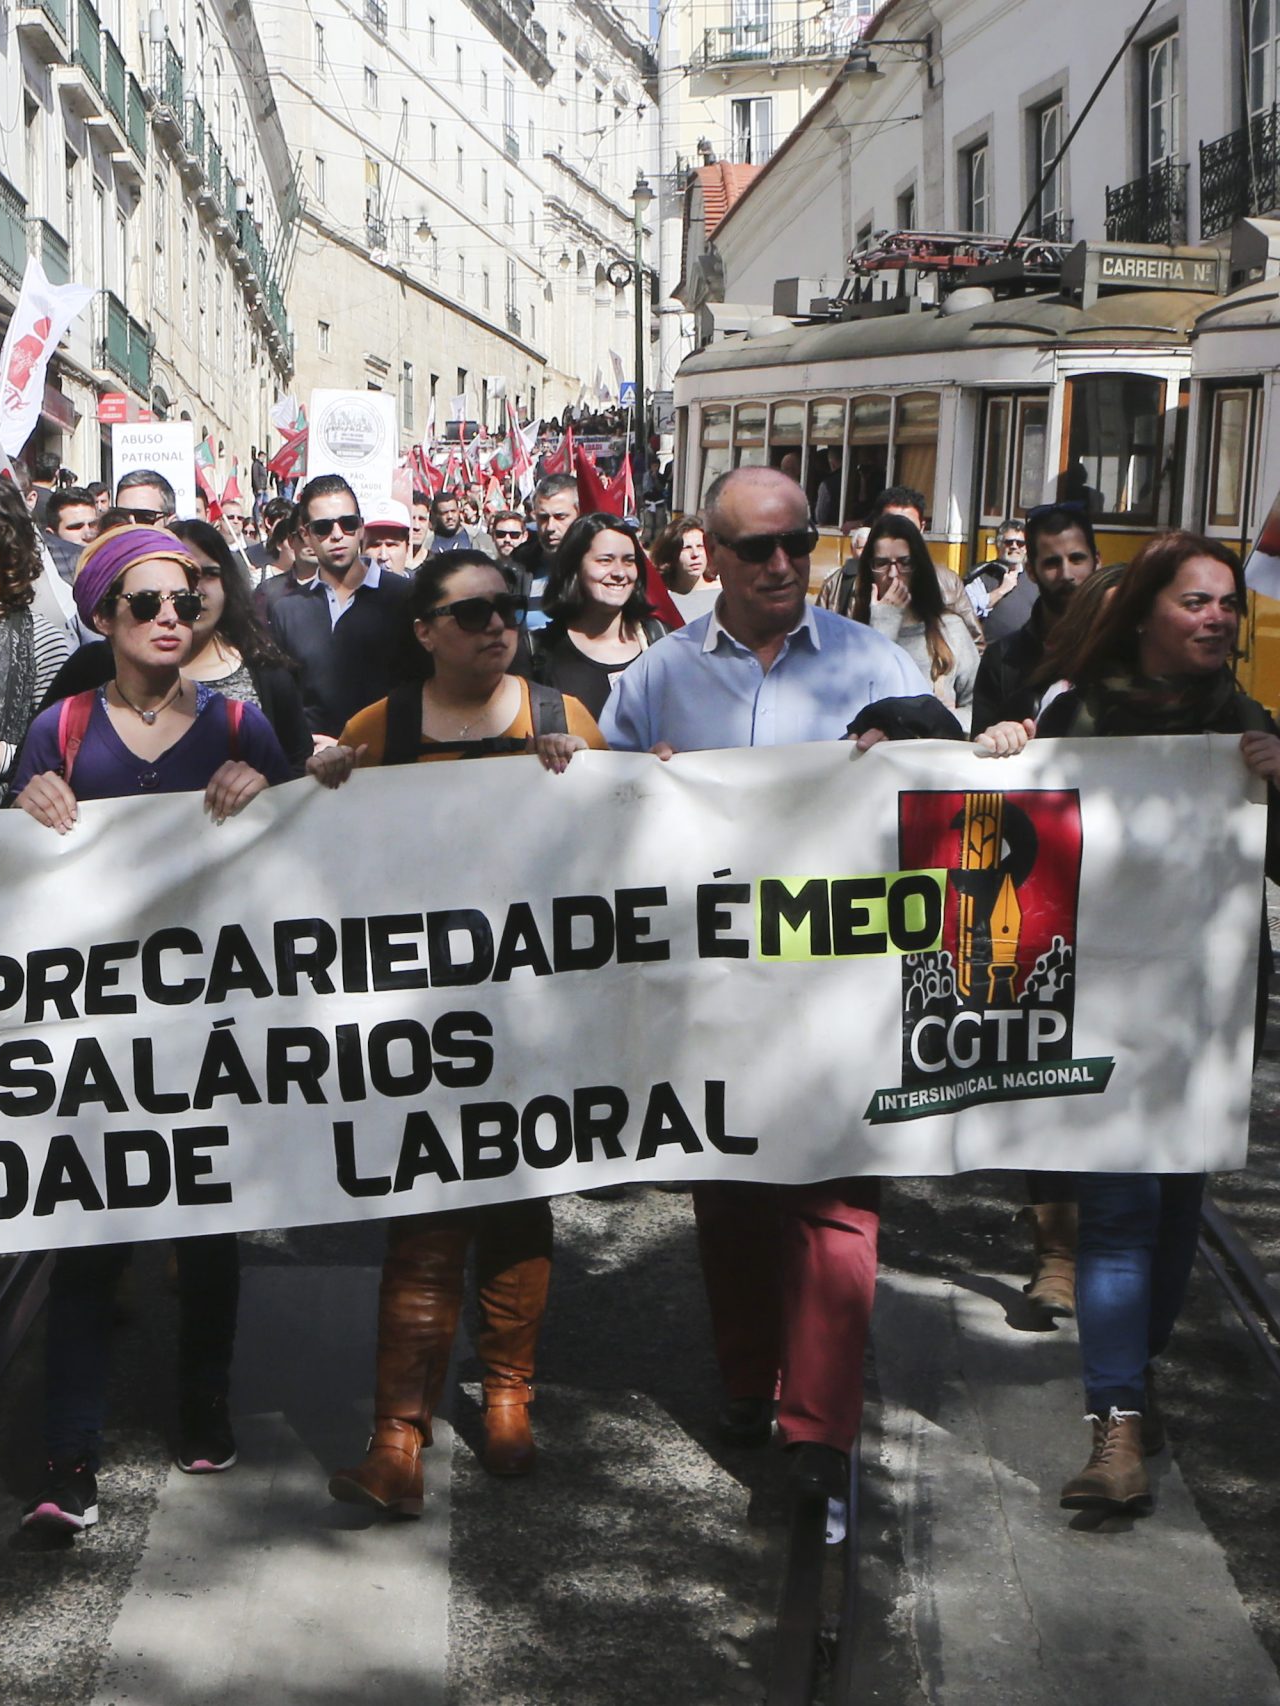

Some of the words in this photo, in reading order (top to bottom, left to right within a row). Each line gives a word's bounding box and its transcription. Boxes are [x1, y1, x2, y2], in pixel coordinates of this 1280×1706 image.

[1103, 257, 1185, 280] CARREIRA
[121, 433, 163, 445] ABUSO
[121, 451, 184, 463] PATRONAL
[697, 867, 751, 959] É
[761, 875, 942, 956] MEO
[910, 1009, 1067, 1073] CGTP
[878, 1074, 998, 1111] INTERSINDICAL
[1003, 1066, 1094, 1088] NACIONAL
[333, 1080, 759, 1198] LABORAL
